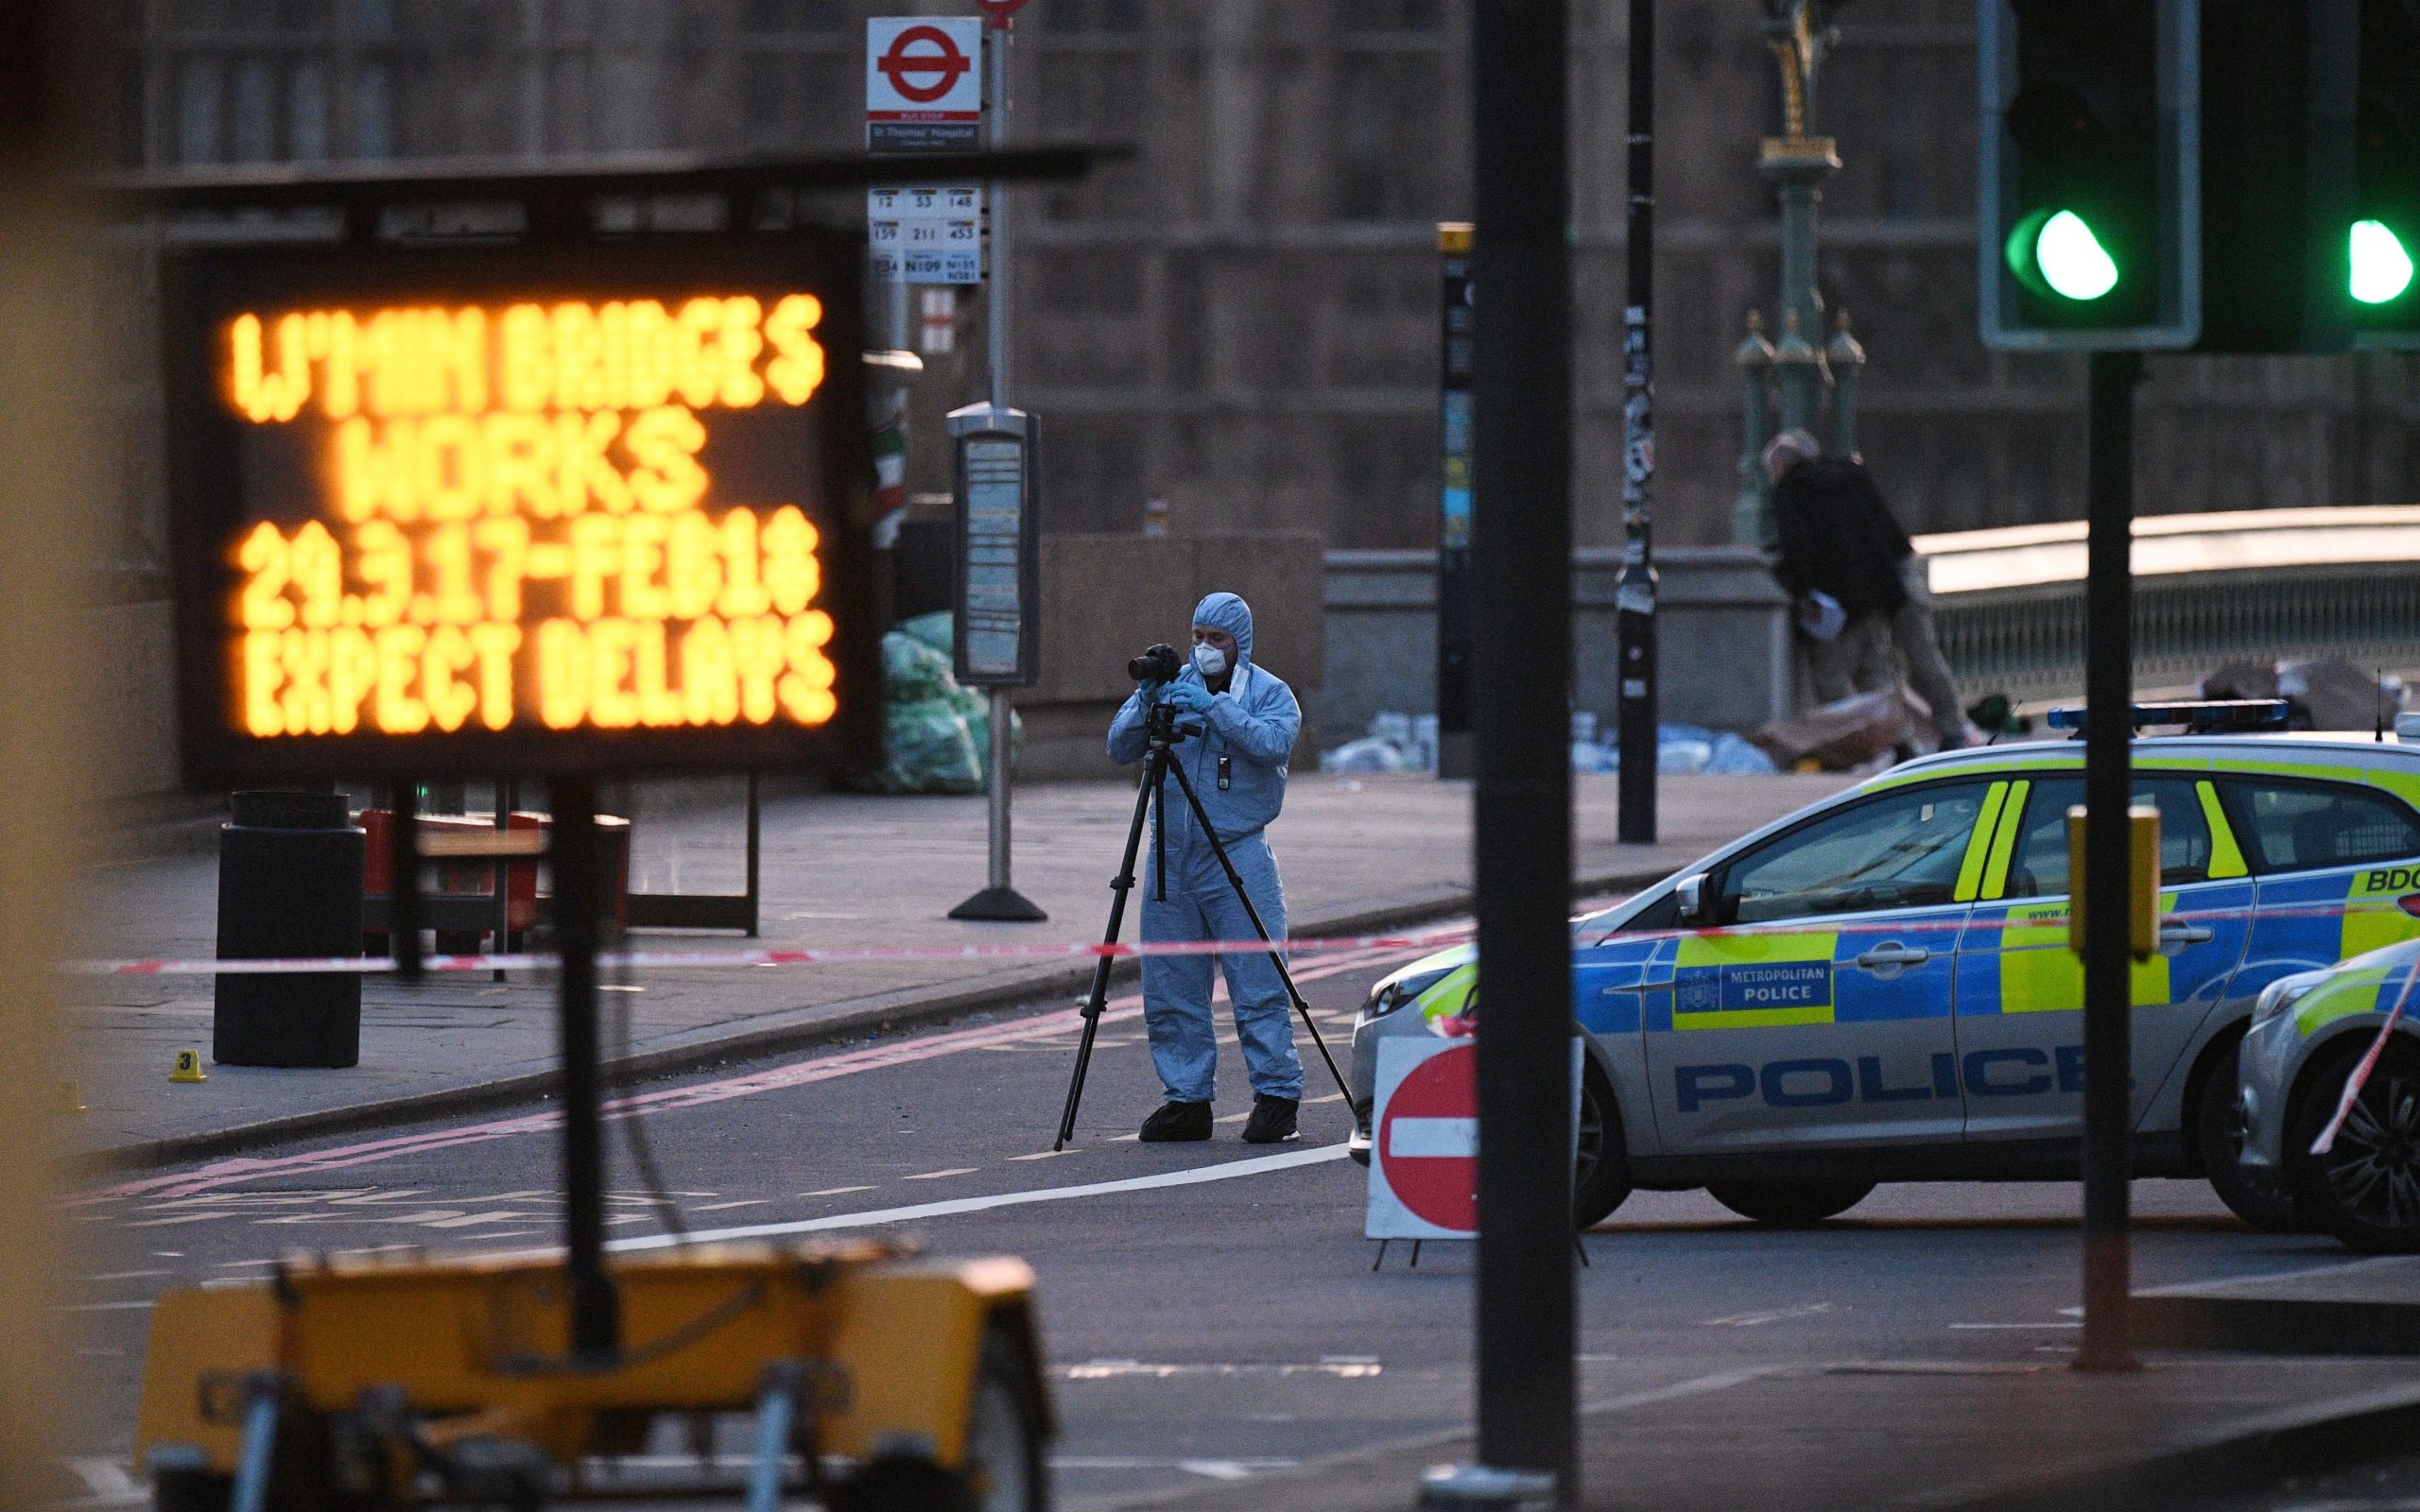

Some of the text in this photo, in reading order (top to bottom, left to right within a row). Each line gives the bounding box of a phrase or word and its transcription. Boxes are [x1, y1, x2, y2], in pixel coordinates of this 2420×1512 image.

[878, 197, 893, 208] 12
[917, 196, 932, 208] 53
[949, 197, 972, 207] 148
[875, 228, 897, 240] 159
[913, 229, 936, 240] 211
[949, 228, 974, 240] 453
[905, 260, 942, 273] N109
[501, 294, 824, 413] BRIDGES
[336, 404, 708, 524] WORKS
[244, 610, 837, 737] EXPECT DELAYS
[1731, 968, 1824, 984] METROPOLITAN
[1744, 986, 1812, 1002] POLICE
[180, 1053, 192, 1070] 3
